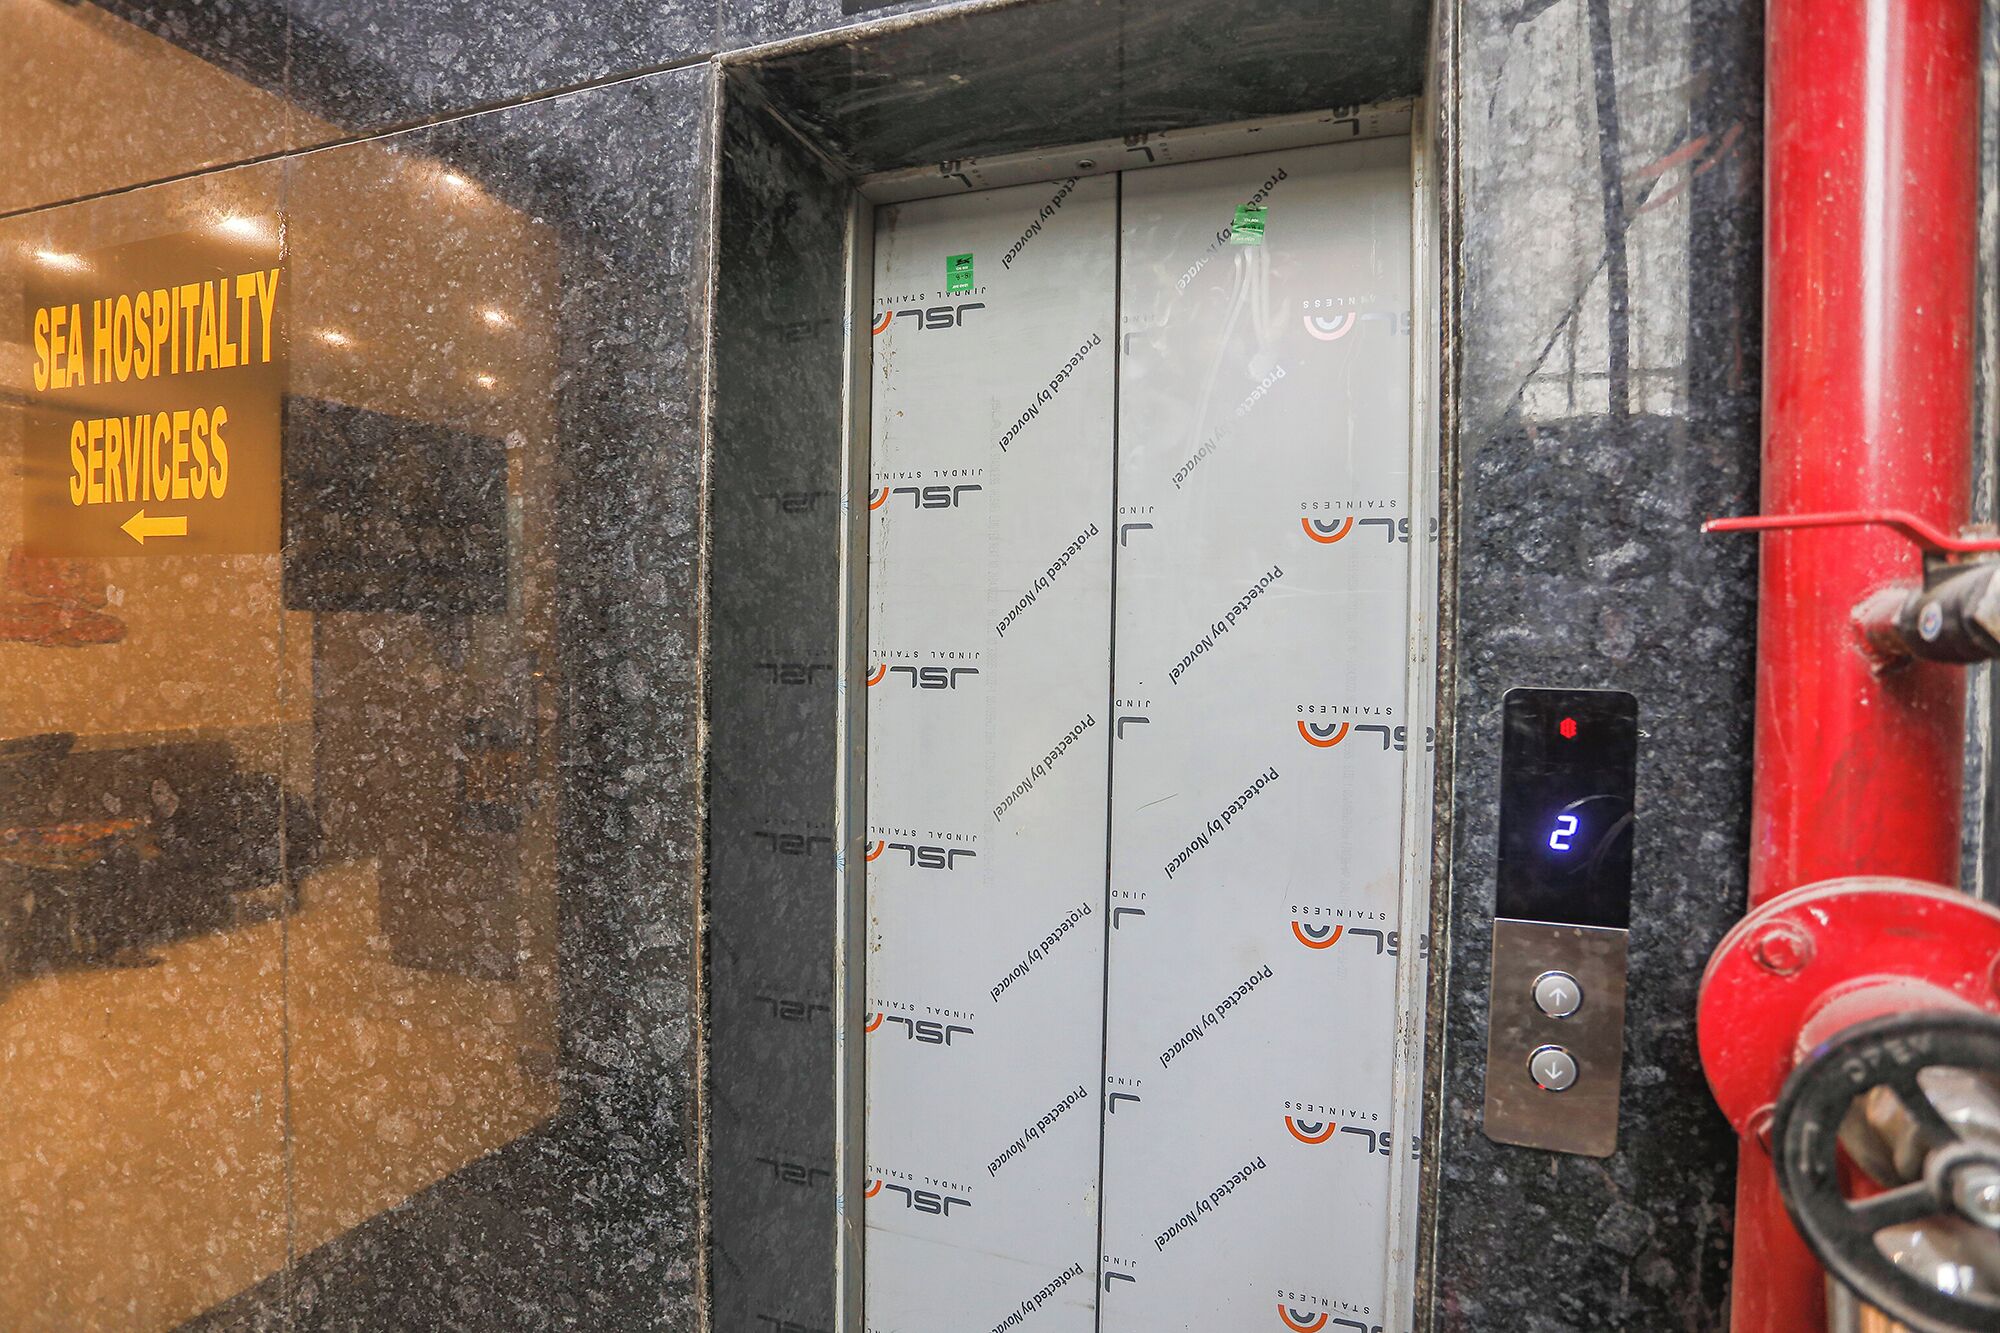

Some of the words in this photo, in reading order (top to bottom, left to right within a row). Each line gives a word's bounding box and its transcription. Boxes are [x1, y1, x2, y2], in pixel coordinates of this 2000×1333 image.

[1040, 205, 1055, 222] by
[1002, 220, 1041, 269] Novacel
[879, 294, 924, 305] STAINL
[896, 303, 985, 330] JSL
[34, 304, 85, 391] SEA
[94, 268, 280, 384] HOSPITALTY
[1049, 333, 1101, 393] Protected
[1037, 389, 1052, 406] by
[999, 404, 1039, 452] Novacel
[70, 405, 229, 506] SERVICESS
[876, 471, 921, 480] STAINL
[934, 469, 983, 477] JINDAL
[893, 485, 982, 509] JSL
[1301, 500, 1396, 510] STAINLESS
[1119, 506, 1154, 514] JIND
[1047, 523, 1099, 581] Protected
[1034, 577, 1049, 593] by
[1225, 565, 1283, 626] Protected
[996, 590, 1036, 637] Novacel
[1212, 621, 1228, 639] by
[873, 650, 918, 658] STAINL
[931, 651, 979, 659] JINDAL
[1169, 635, 1213, 685] Novacel
[890, 666, 979, 689] JSL
[1297, 705, 1392, 715] STAINLESS
[1043, 714, 1095, 769] Protected
[1031, 765, 1046, 781] by
[993, 777, 1033, 822] Novacel
[1221, 767, 1279, 824] Protected
[871, 826, 916, 837] STAINL
[929, 832, 977, 842] JINDAL
[1207, 819, 1224, 836] by
[1549, 815, 1578, 850] 2
[888, 843, 976, 870] JSL
[1165, 832, 1209, 879] Novacel
[1112, 890, 1146, 900] JIND
[1292, 905, 1385, 920] STAINLESS
[1040, 902, 1092, 954] Protected
[1028, 949, 1043, 965] by
[990, 961, 1029, 1003] Novacel
[1215, 965, 1273, 1019] Protected
[872, 999, 914, 1011] STAINL
[926, 1007, 974, 1020] JINDAL
[886, 1016, 974, 1046] JSL
[1202, 1013, 1218, 1029] by
[1160, 1025, 1203, 1068] Novacel
[1108, 1076, 1141, 1086] JIND
[1036, 1085, 1087, 1133] Protected
[1285, 1101, 1377, 1121] STAINLESS
[1025, 1128, 1039, 1142] by
[988, 1138, 1026, 1177] Novacel
[867, 1165, 912, 1181] STAINL
[1209, 1156, 1266, 1206] Protected
[923, 1177, 972, 1193] JINDAL
[885, 1184, 972, 1217] JSL
[1196, 1200, 1212, 1215] by
[1154, 1211, 1198, 1252] Novacel
[1103, 1255, 1136, 1268] JIND
[1033, 1263, 1083, 1307] Protected
[1022, 1301, 1036, 1315] by
[1278, 1290, 1369, 1315] STAINLESS
[989, 1310, 1023, 1333] Novac
